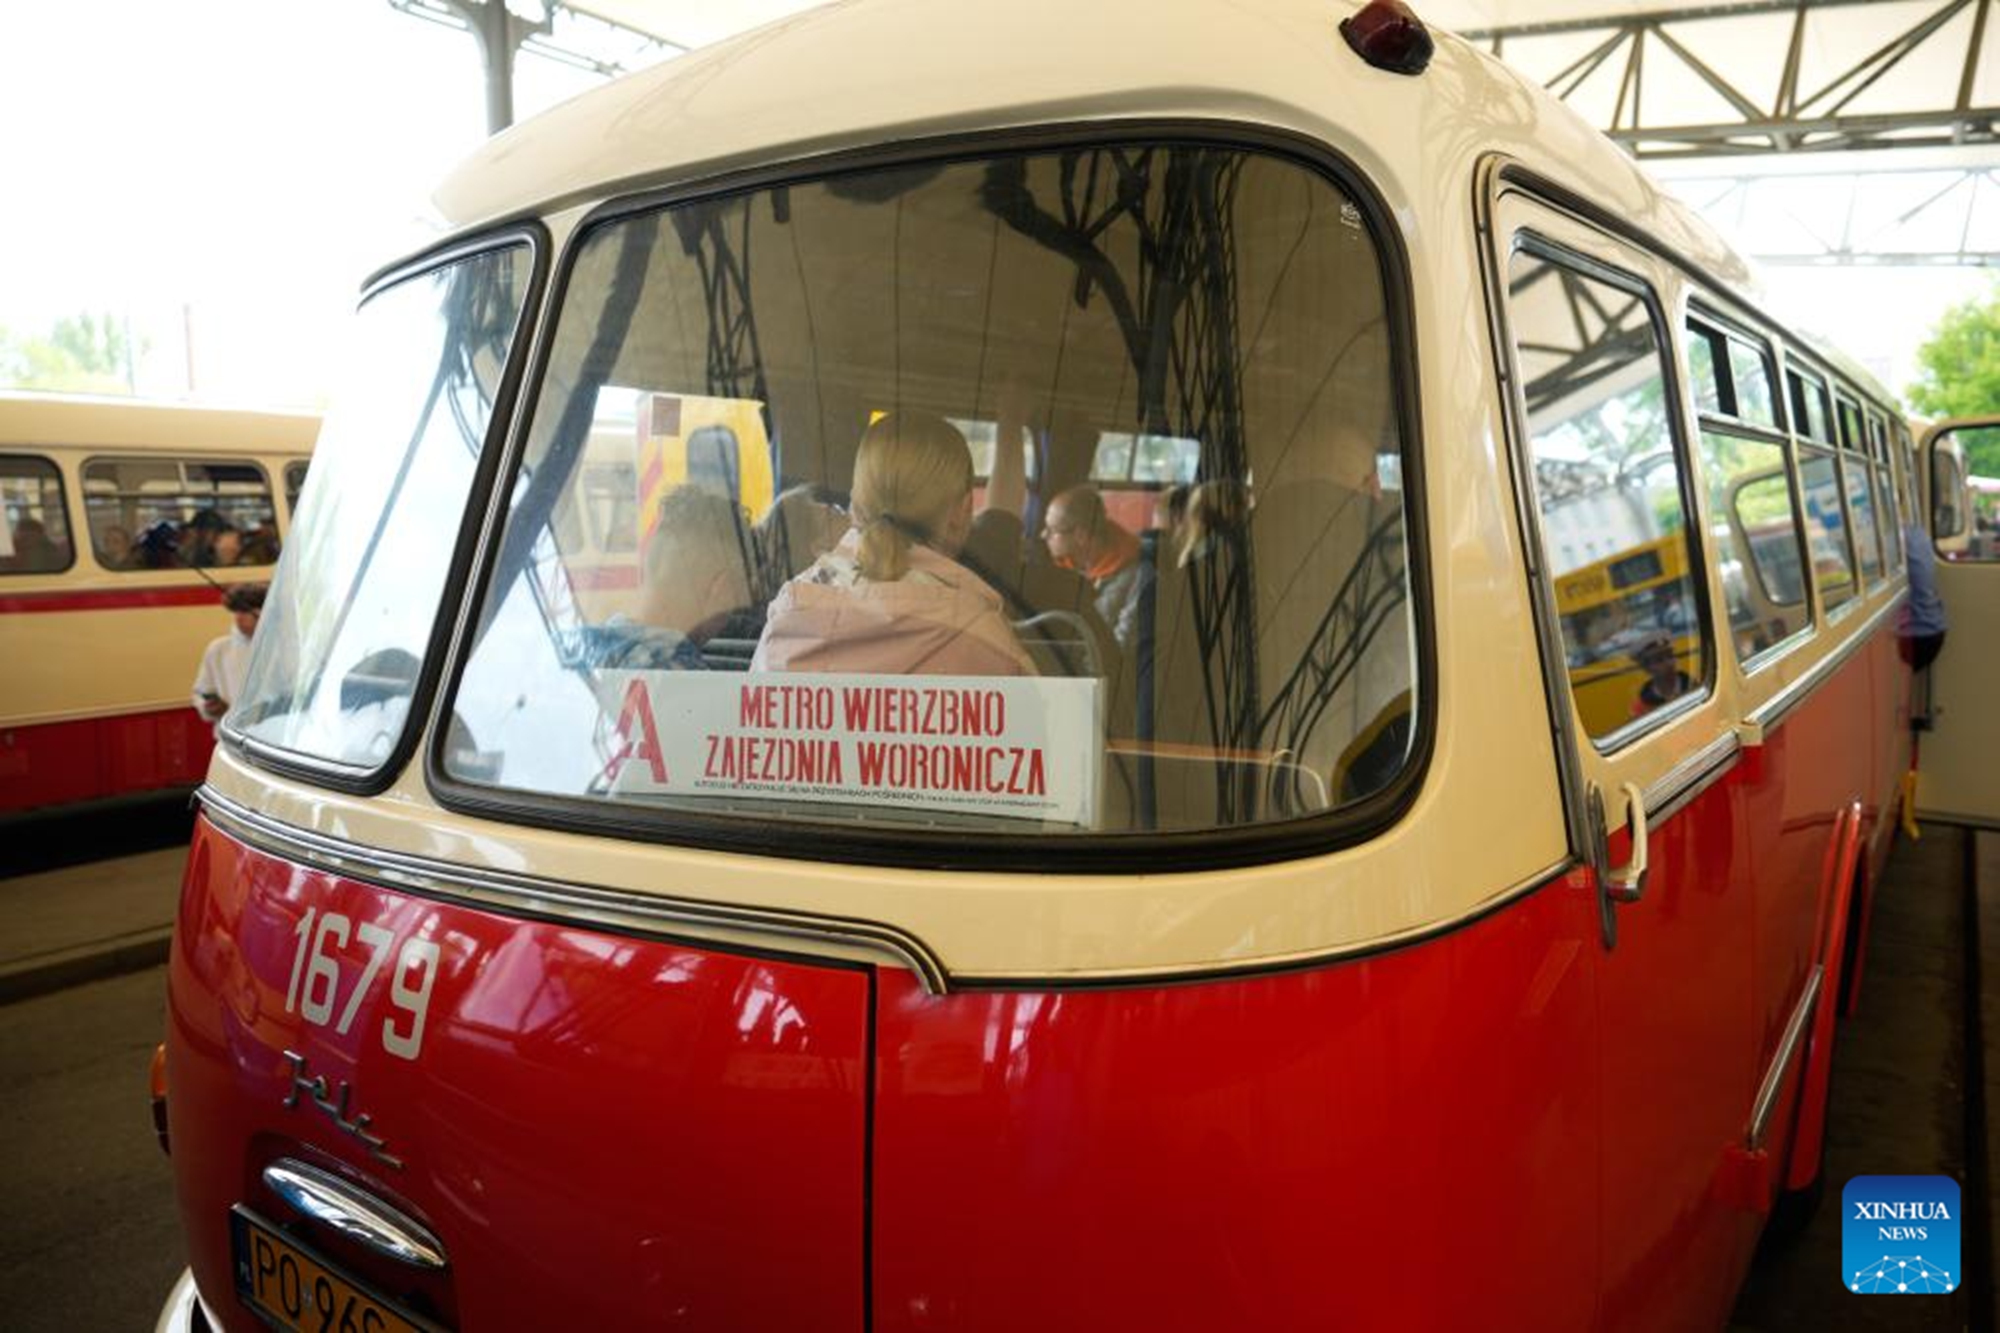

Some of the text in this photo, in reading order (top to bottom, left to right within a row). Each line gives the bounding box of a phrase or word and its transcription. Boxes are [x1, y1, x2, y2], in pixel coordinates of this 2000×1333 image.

[604, 678, 669, 784] A
[739, 684, 1005, 738] METRO WIERZBNO
[704, 734, 843, 784] ZAJEZDNIA
[857, 740, 1046, 796] WORONICZA
[285, 906, 441, 1061] 1679
[255, 1235, 300, 1319] PO
